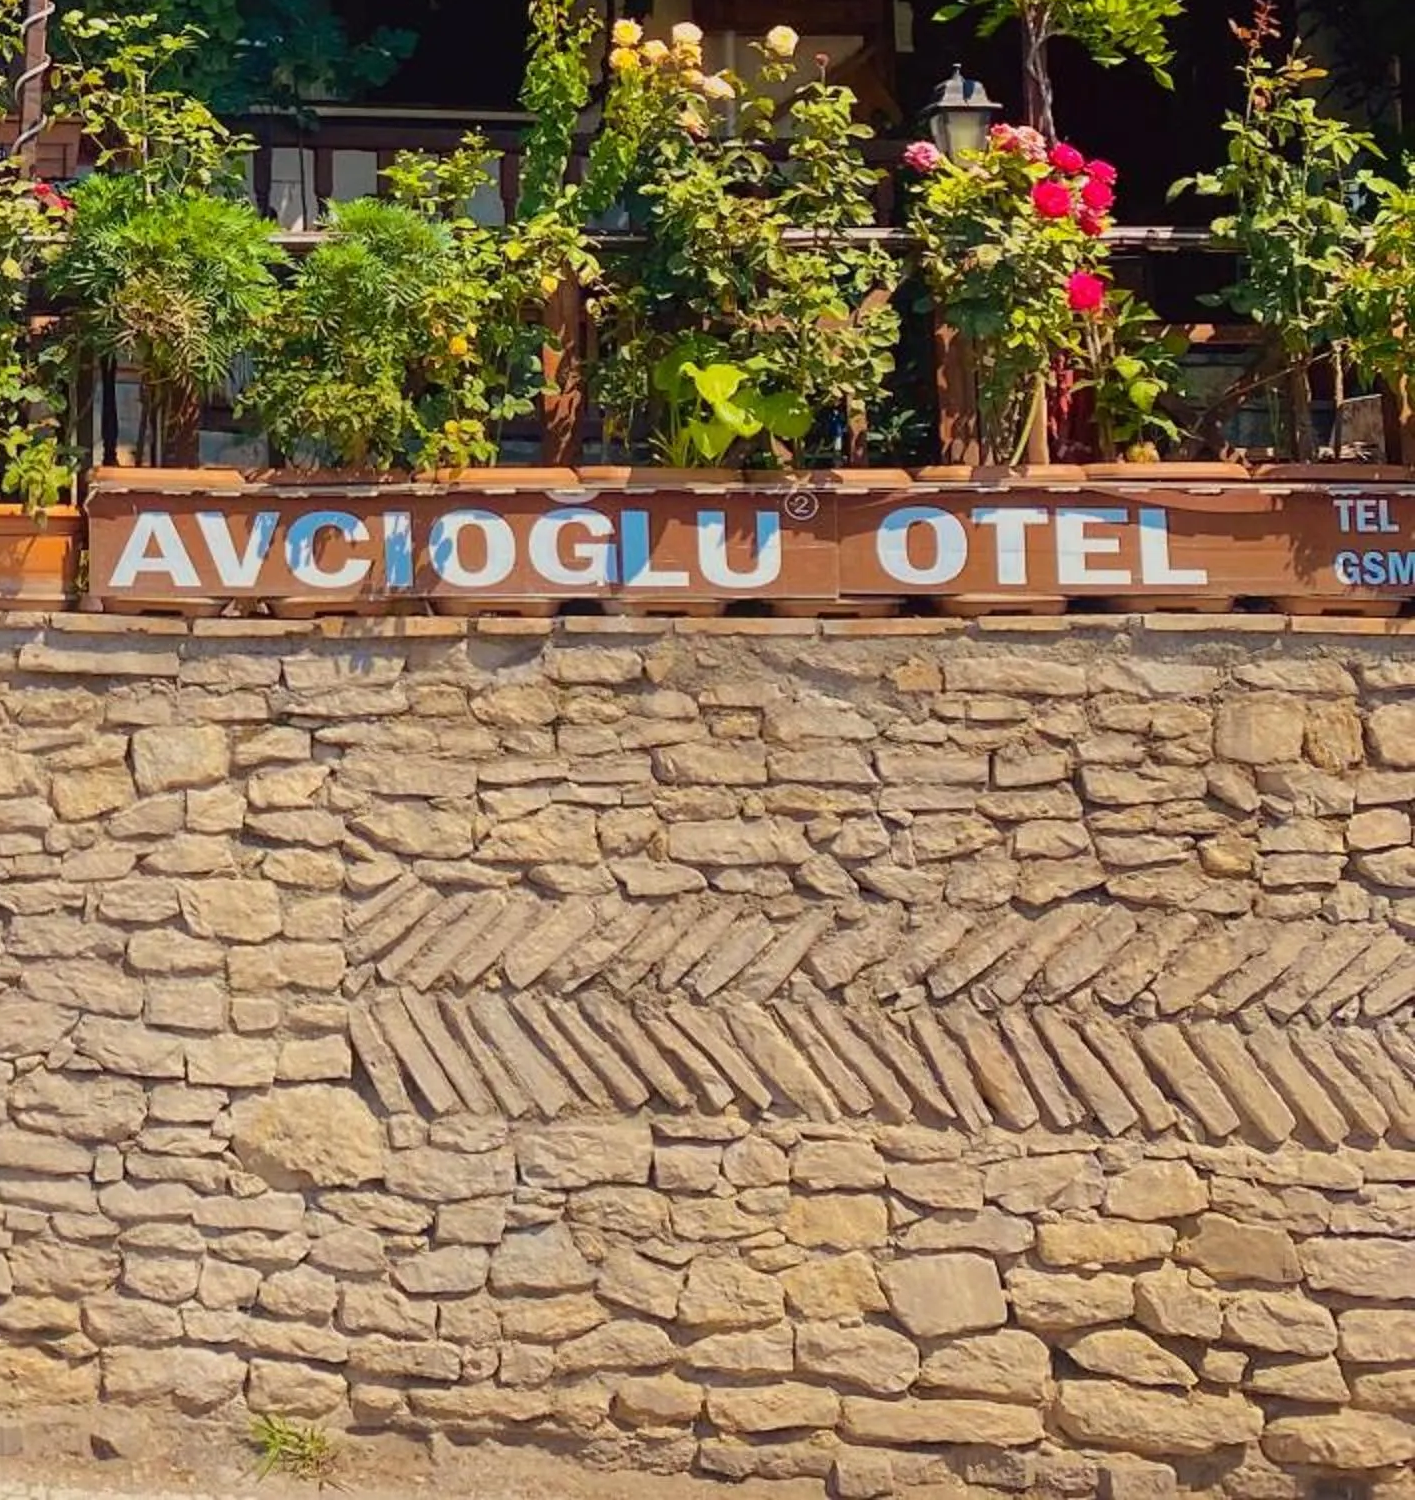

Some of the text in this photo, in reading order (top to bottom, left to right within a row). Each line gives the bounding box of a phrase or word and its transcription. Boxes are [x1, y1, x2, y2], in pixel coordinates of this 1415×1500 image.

[1333, 500, 1399, 532] TEL
[108, 488, 1208, 588] AVCIOĞLU OTEL
[1334, 551, 1415, 585] GSM
